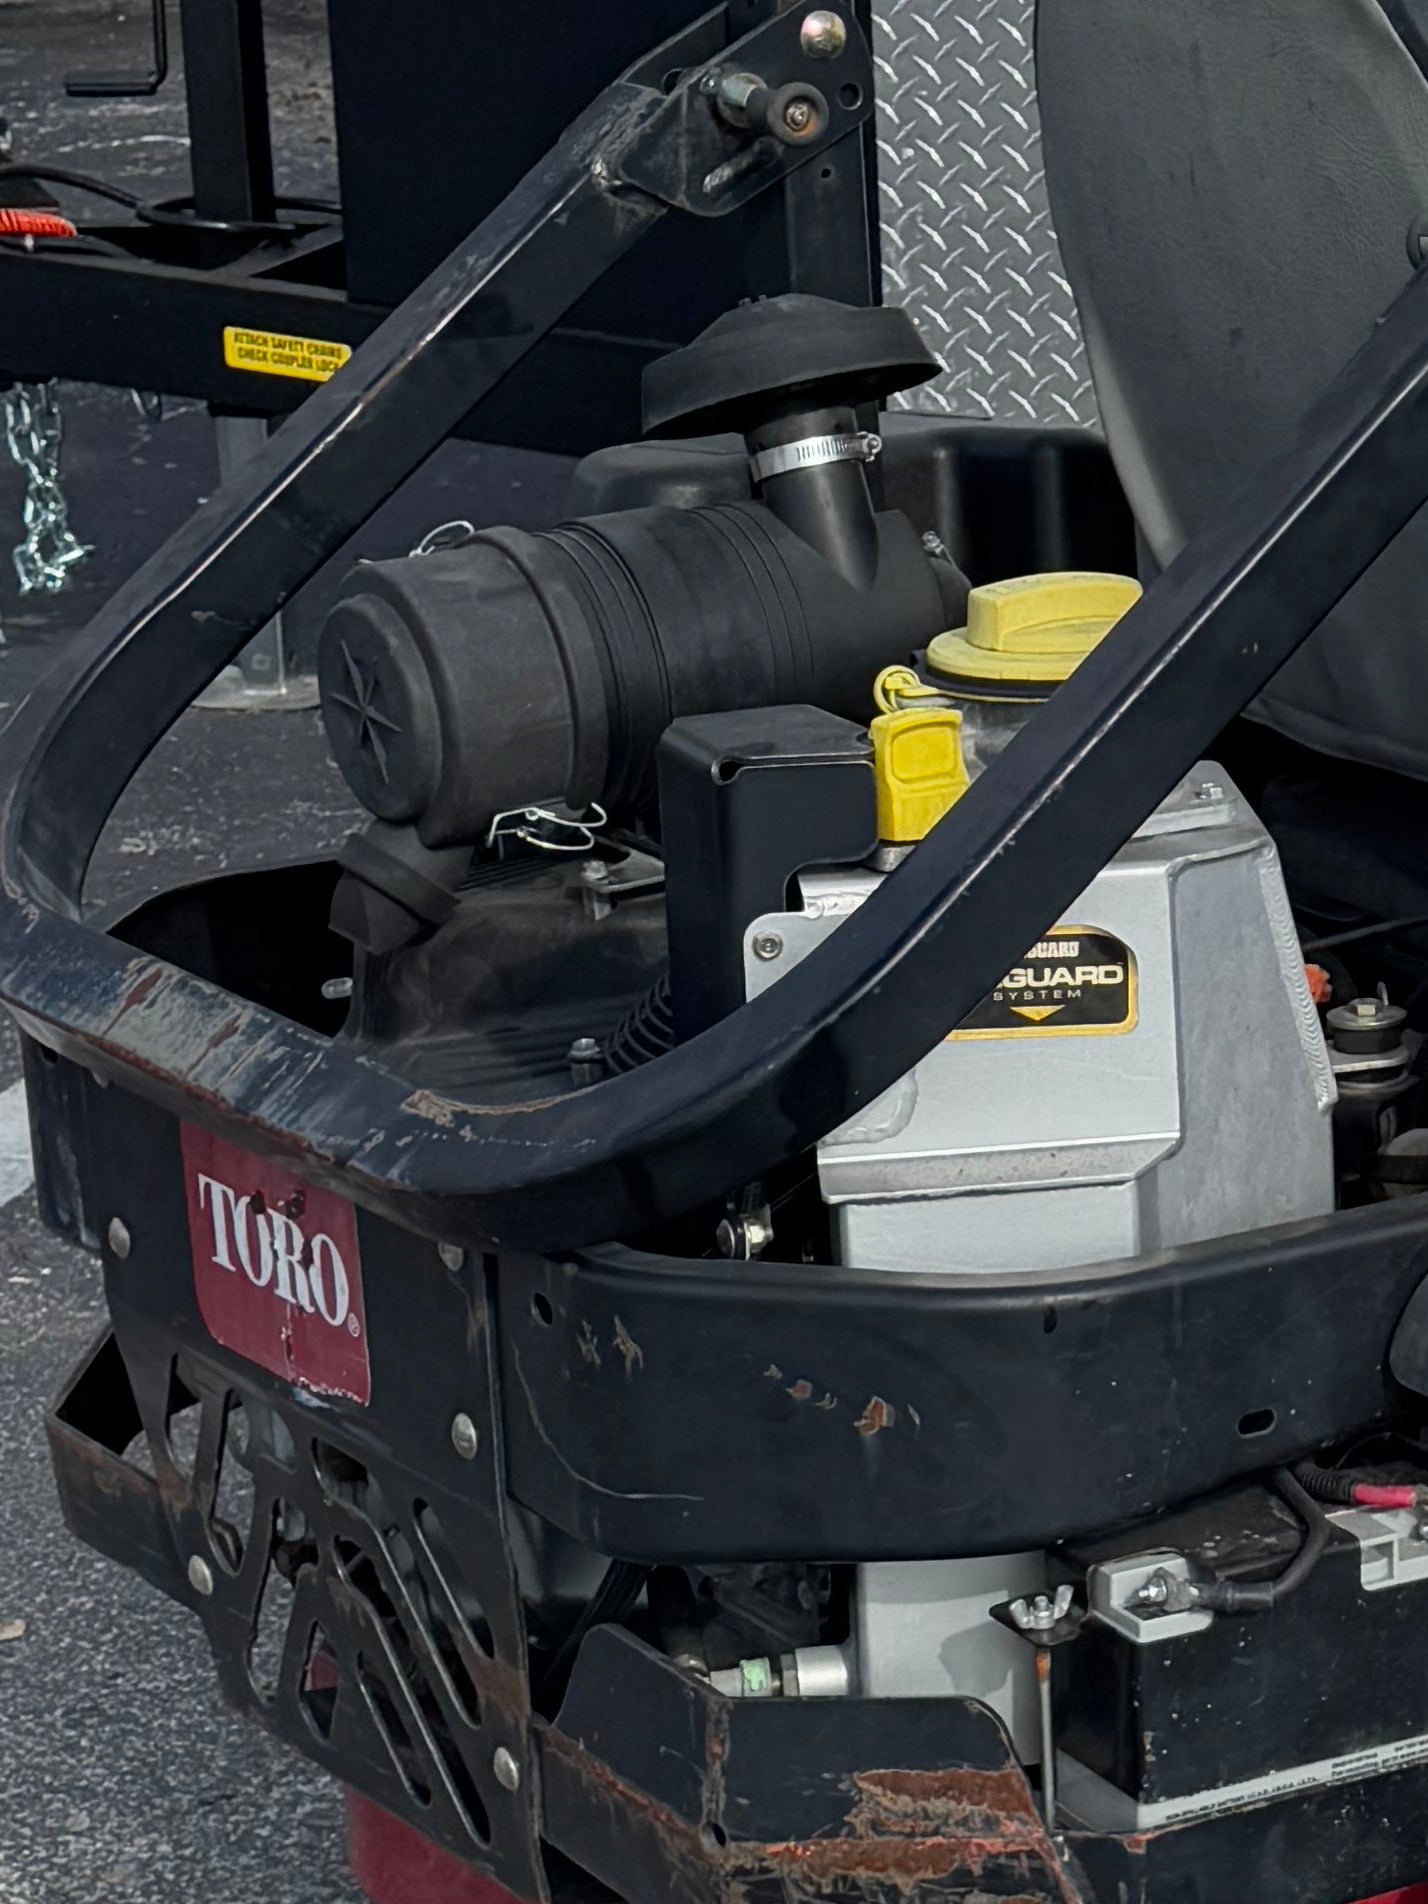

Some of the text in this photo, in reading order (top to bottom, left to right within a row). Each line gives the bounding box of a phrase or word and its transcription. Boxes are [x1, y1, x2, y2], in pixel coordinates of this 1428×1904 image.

[234, 332, 342, 360] ATTACH SAFETY CHAINS
[237, 347, 268, 362] CHECK
[270, 352, 314, 369] COUPLER
[997, 965, 1124, 988] GUARD
[993, 989, 1081, 1001] SYSTEM
[198, 1173, 349, 1327] TORO
